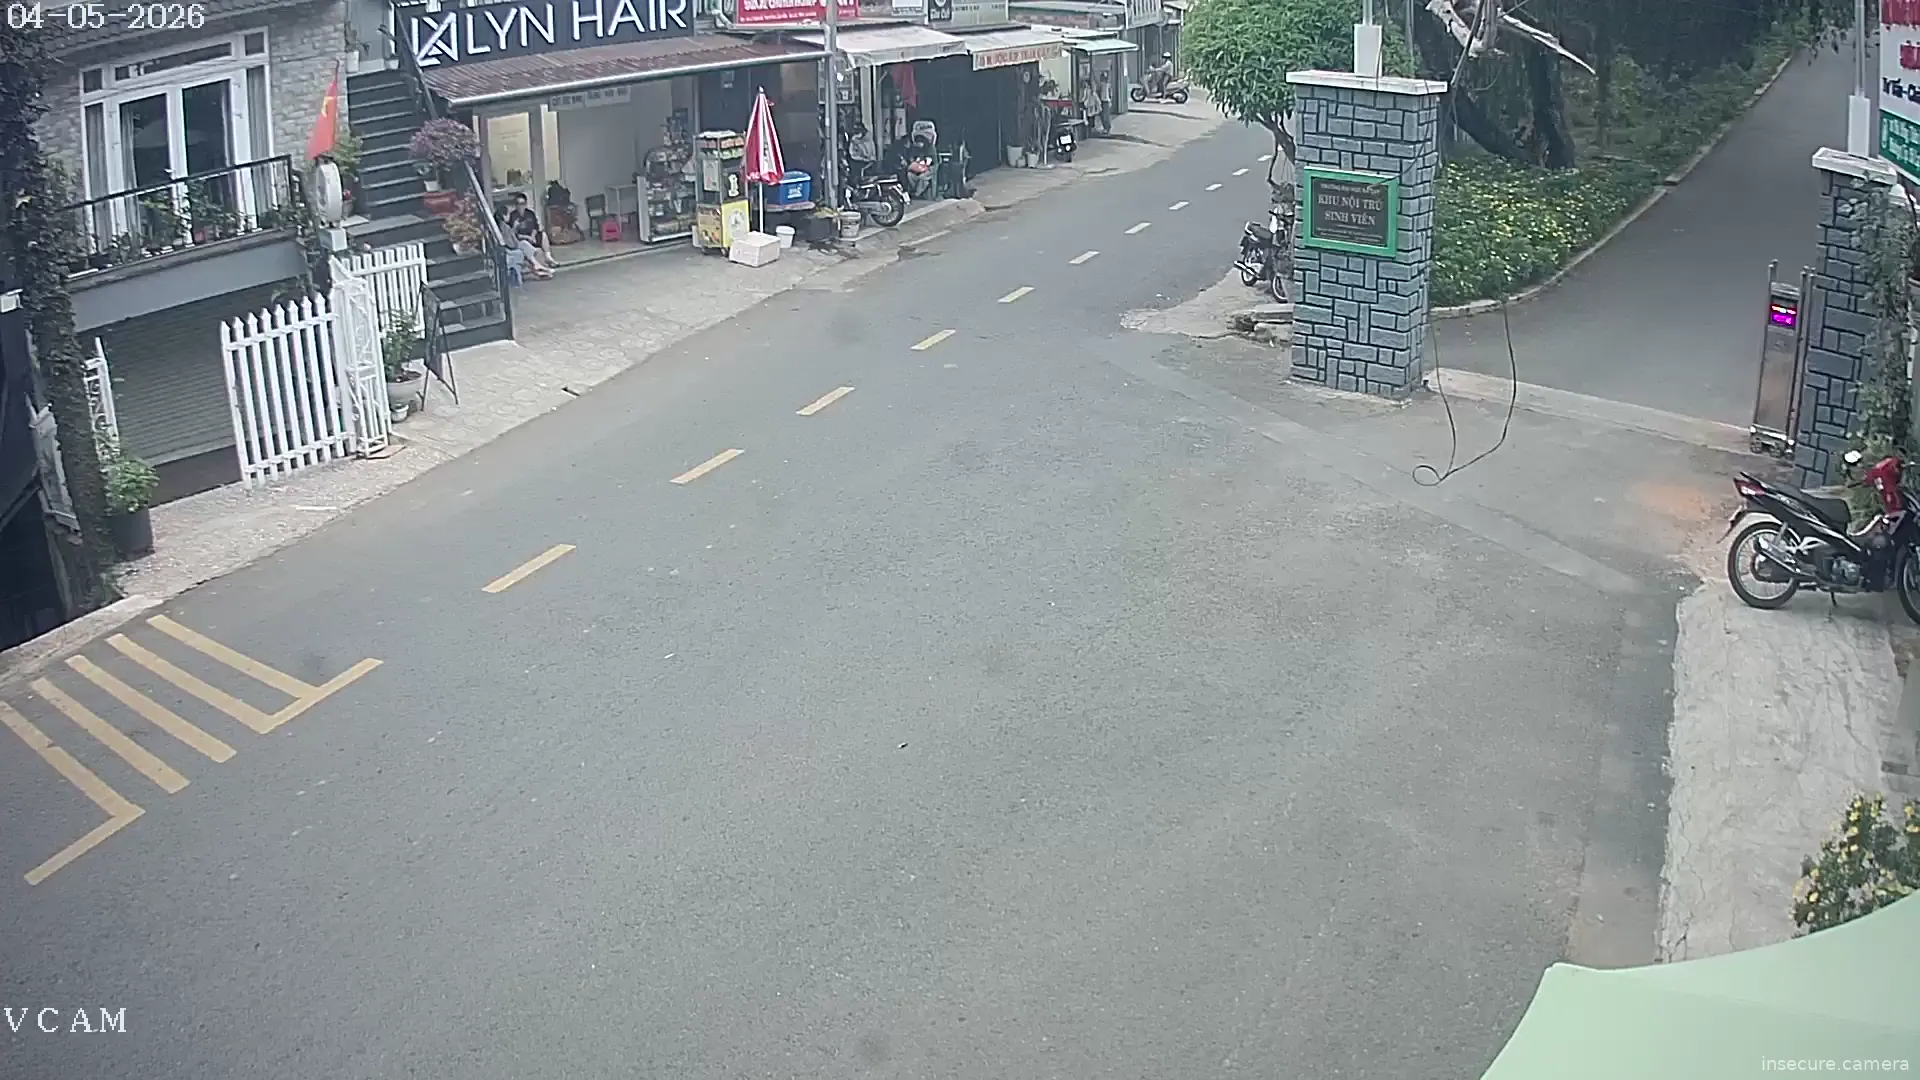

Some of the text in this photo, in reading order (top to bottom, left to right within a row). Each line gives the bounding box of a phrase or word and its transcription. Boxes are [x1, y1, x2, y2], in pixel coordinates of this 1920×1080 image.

[465, 2, 555, 55] LYN
[572, 0, 687, 41] HAIR
[1318, 194, 1340, 206] KHU
[1341, 195, 1360, 209] NỘI
[1325, 210, 1376, 225] SINH VIÊN
